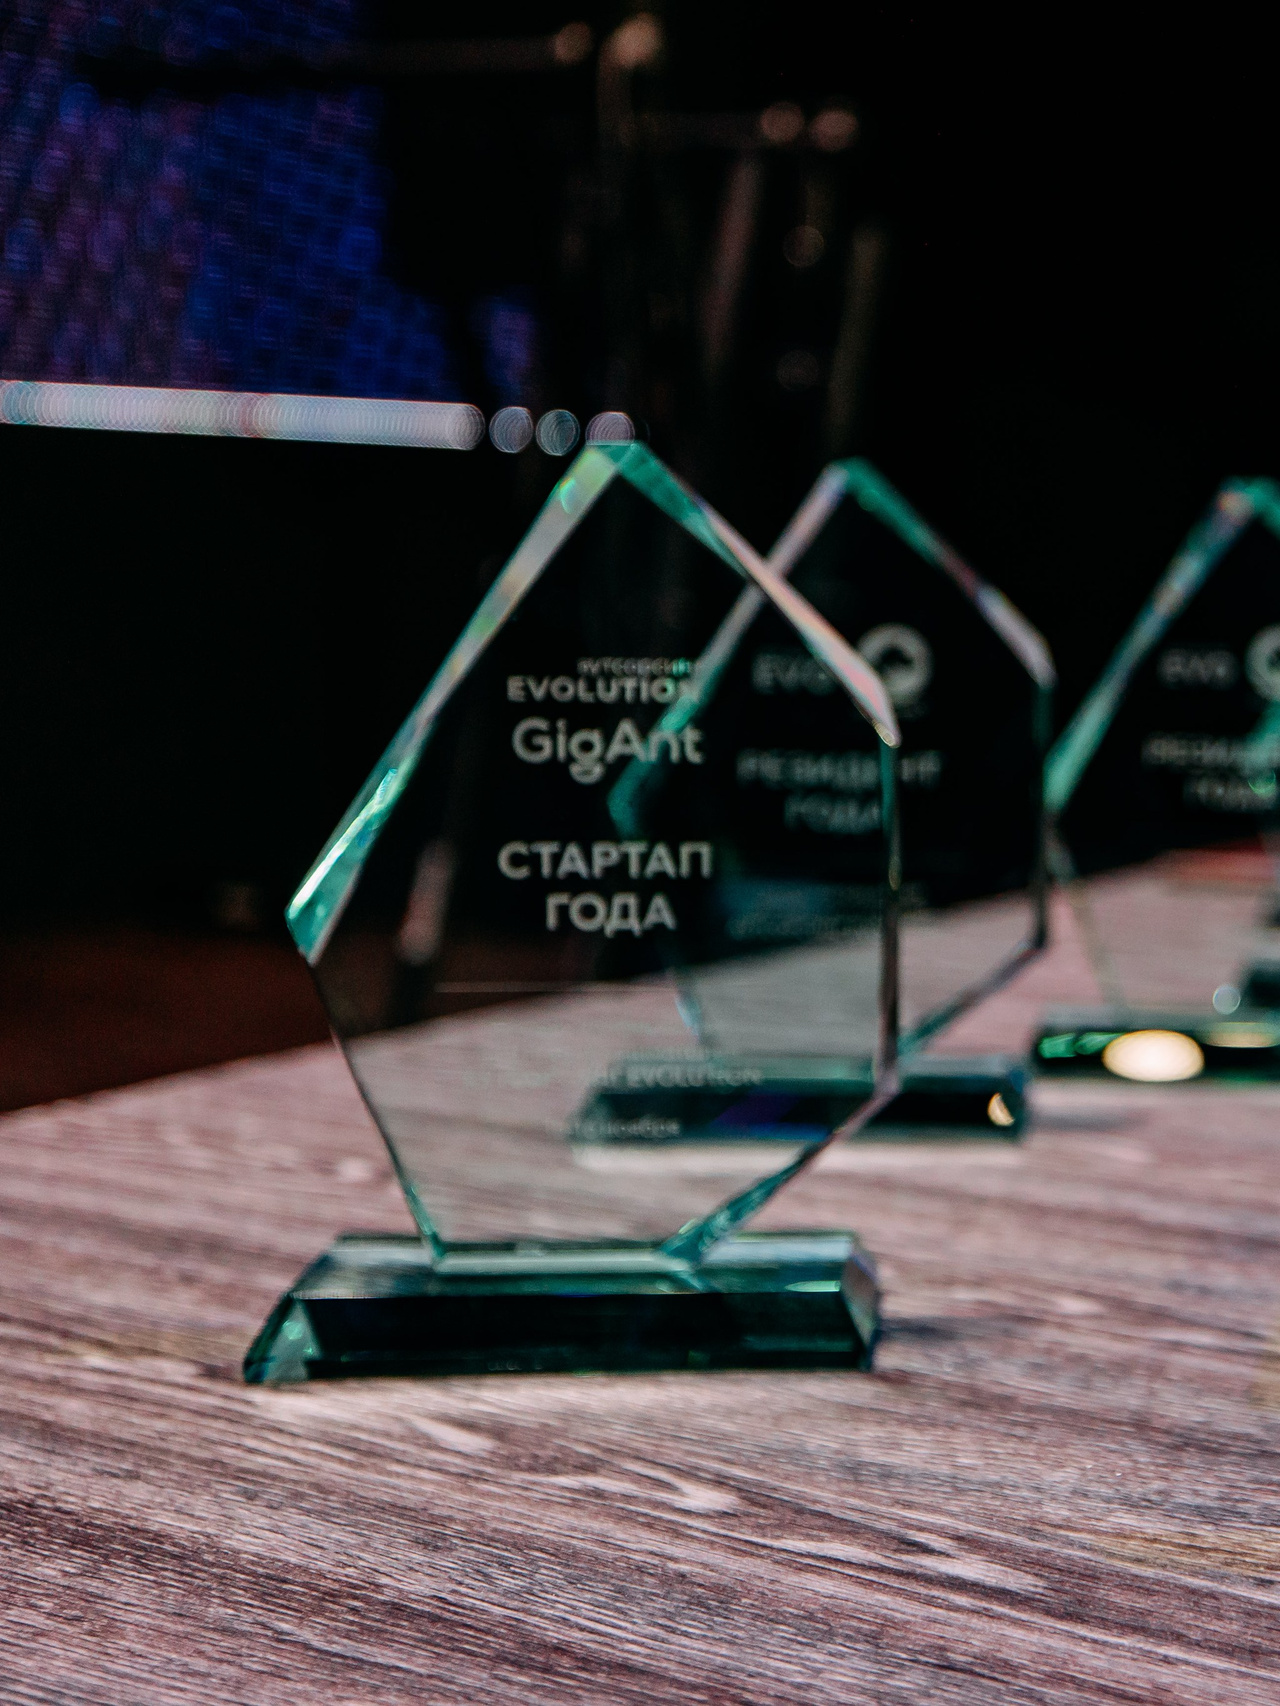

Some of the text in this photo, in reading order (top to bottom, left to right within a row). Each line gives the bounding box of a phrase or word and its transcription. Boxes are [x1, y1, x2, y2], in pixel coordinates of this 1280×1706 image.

[506, 674, 702, 704] EVOLUTION
[510, 715, 706, 785] GigAnt
[497, 838, 714, 881] СТАРТАП
[545, 890, 679, 938] ГОДА
